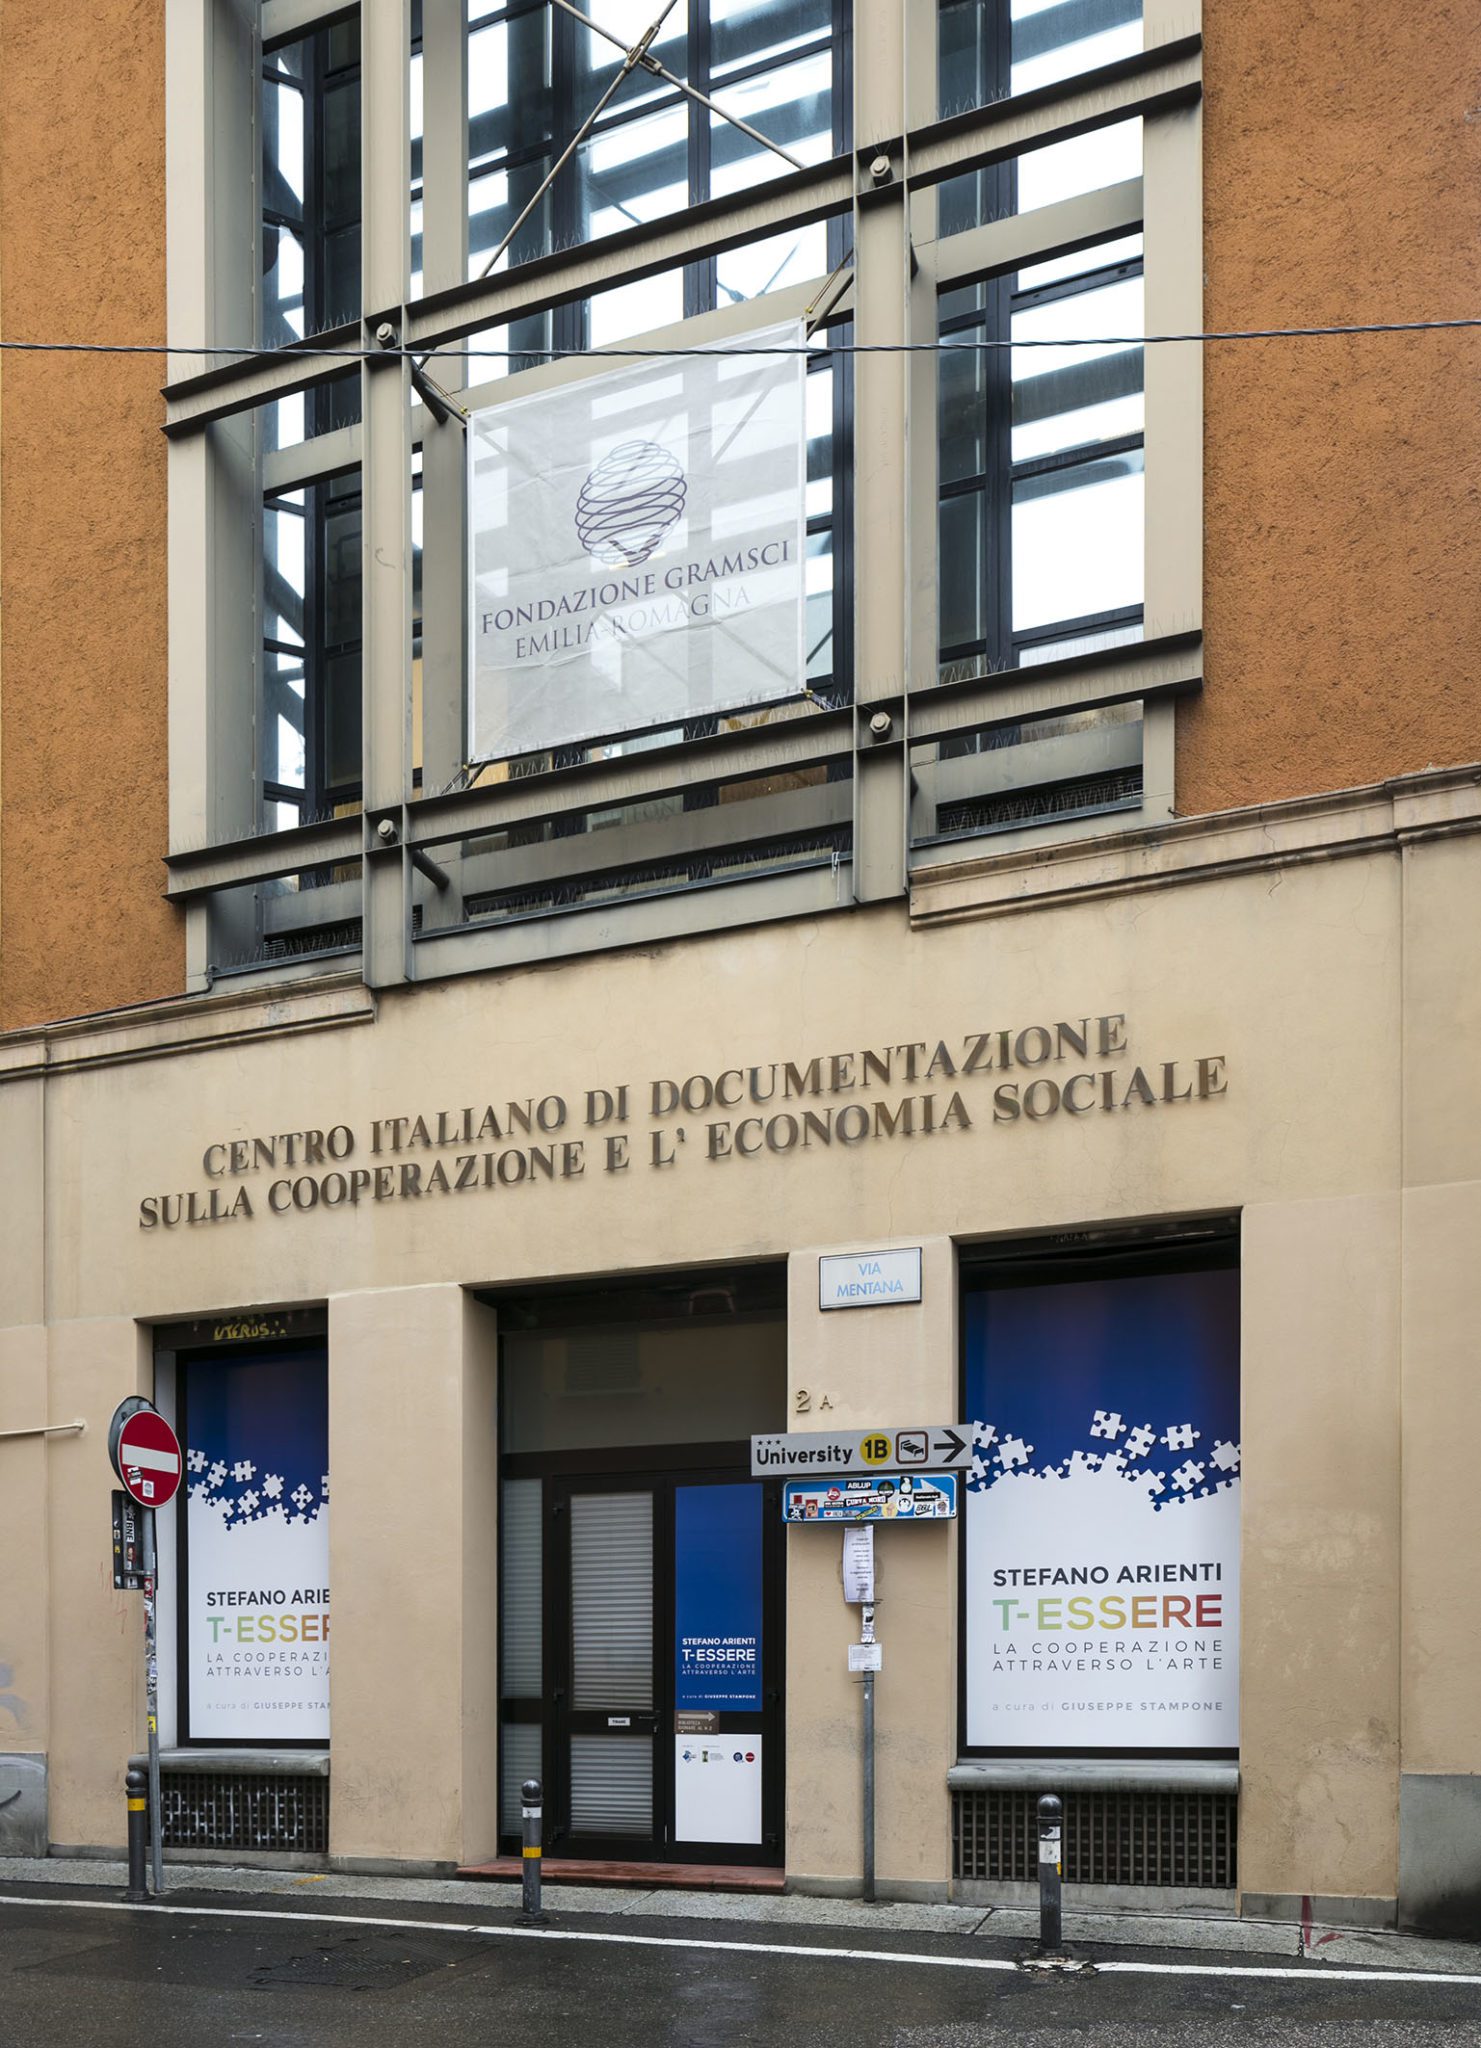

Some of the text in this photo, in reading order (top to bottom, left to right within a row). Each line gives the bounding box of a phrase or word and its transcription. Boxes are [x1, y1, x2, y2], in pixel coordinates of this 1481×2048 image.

[482, 540, 790, 634] FONDAZIONE GRAMSCI
[516, 584, 751, 659] EMILIA-ROMAGNA
[202, 1013, 1129, 1177] CENTRO ITALIANO DI DOCUMENTAZIONE
[138, 1185, 254, 1229] SULLA
[267, 1141, 586, 1212] COOPERAZIONE
[604, 1134, 630, 1172] E
[704, 1091, 974, 1160] ECONOMIA
[992, 1055, 1230, 1122] SOCIALE
[858, 1262, 882, 1276] VIA
[836, 1279, 904, 1297] MENTANA
[795, 1389, 833, 1413] 2 A
[756, 1439, 888, 1465] University 1B
[993, 1563, 1222, 1587] STEFANO ARIENTI
[207, 1590, 286, 1606] STEFANO
[992, 1593, 1223, 1631] T-ESSERE
[682, 1637, 756, 1646] STEFANO ARIENTI
[993, 1640, 1223, 1654] LA COOPERAZIONE
[207, 1653, 224, 1663] LA
[682, 1648, 756, 1662] T-ESSERE
[206, 1666, 304, 1677] ATTRAVERSO
[993, 1657, 1223, 1672] ATTRAVERSO L'ARTE
[254, 1702, 303, 1710] GIUSEPPE
[992, 1702, 1223, 1711] a cura di GIUSEPPE STAMPONE
